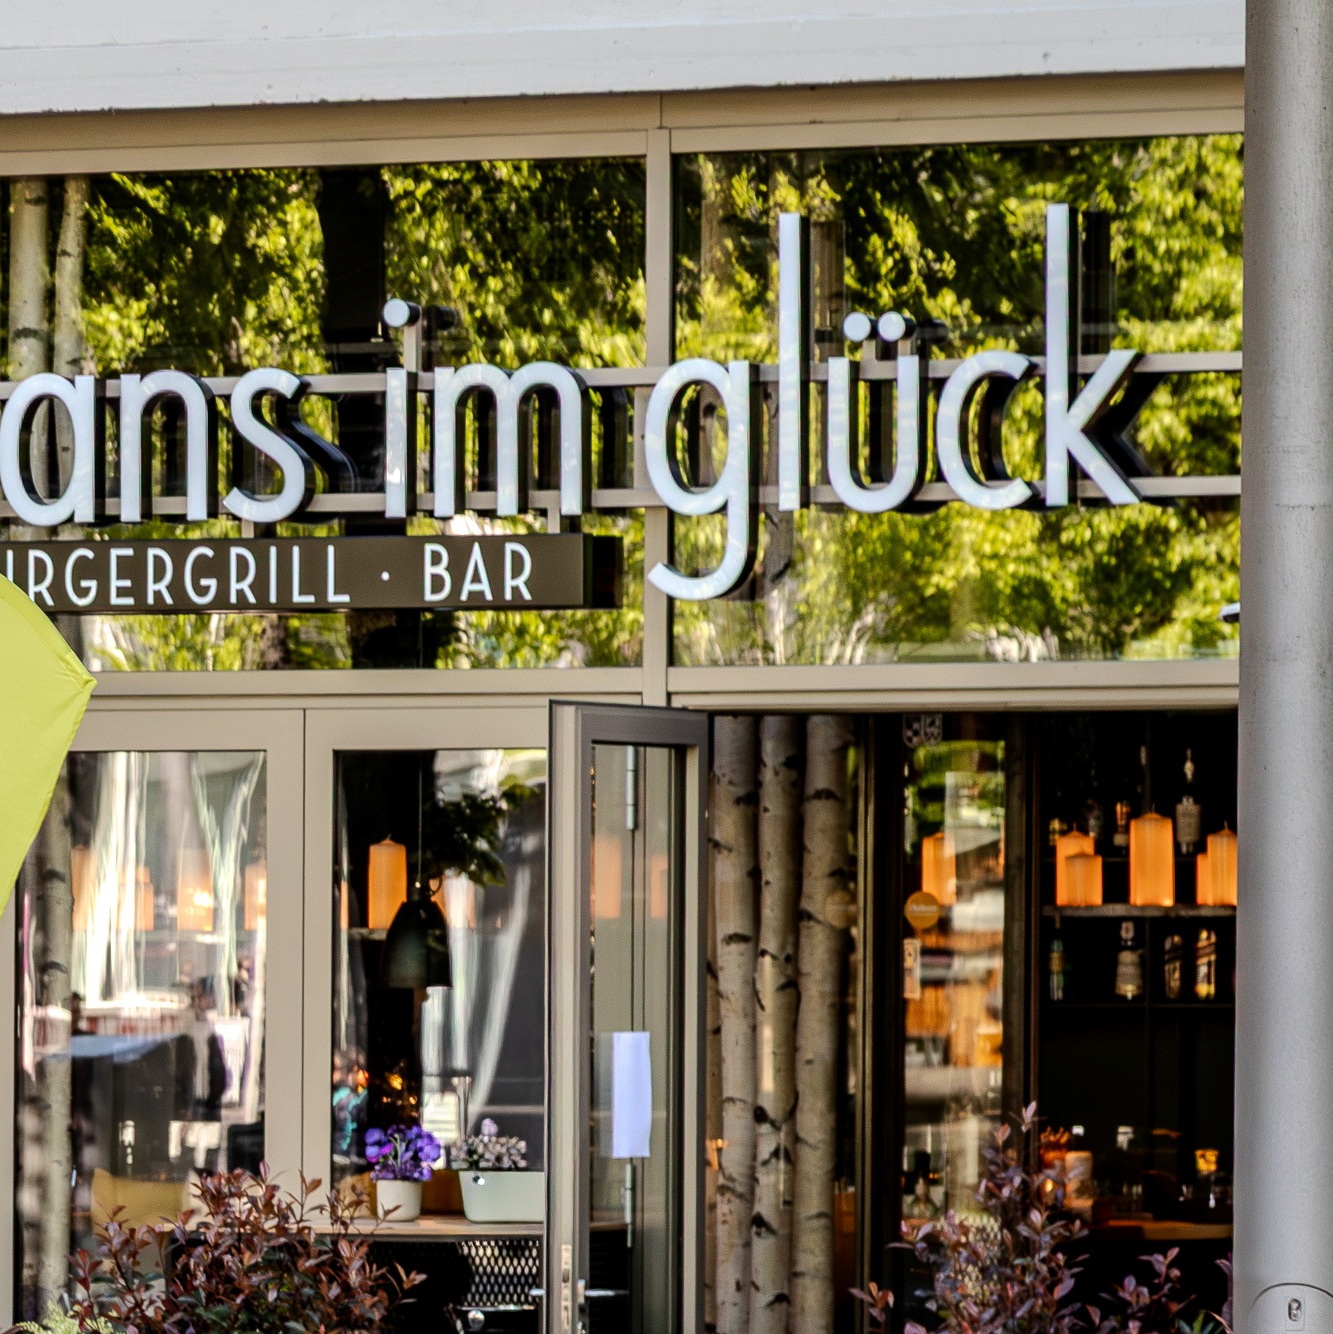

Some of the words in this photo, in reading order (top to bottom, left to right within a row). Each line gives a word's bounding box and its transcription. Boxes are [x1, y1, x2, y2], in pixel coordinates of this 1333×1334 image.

[384, 298, 583, 519] im
[645, 202, 1139, 601] glück
[423, 540, 533, 602] BAR
